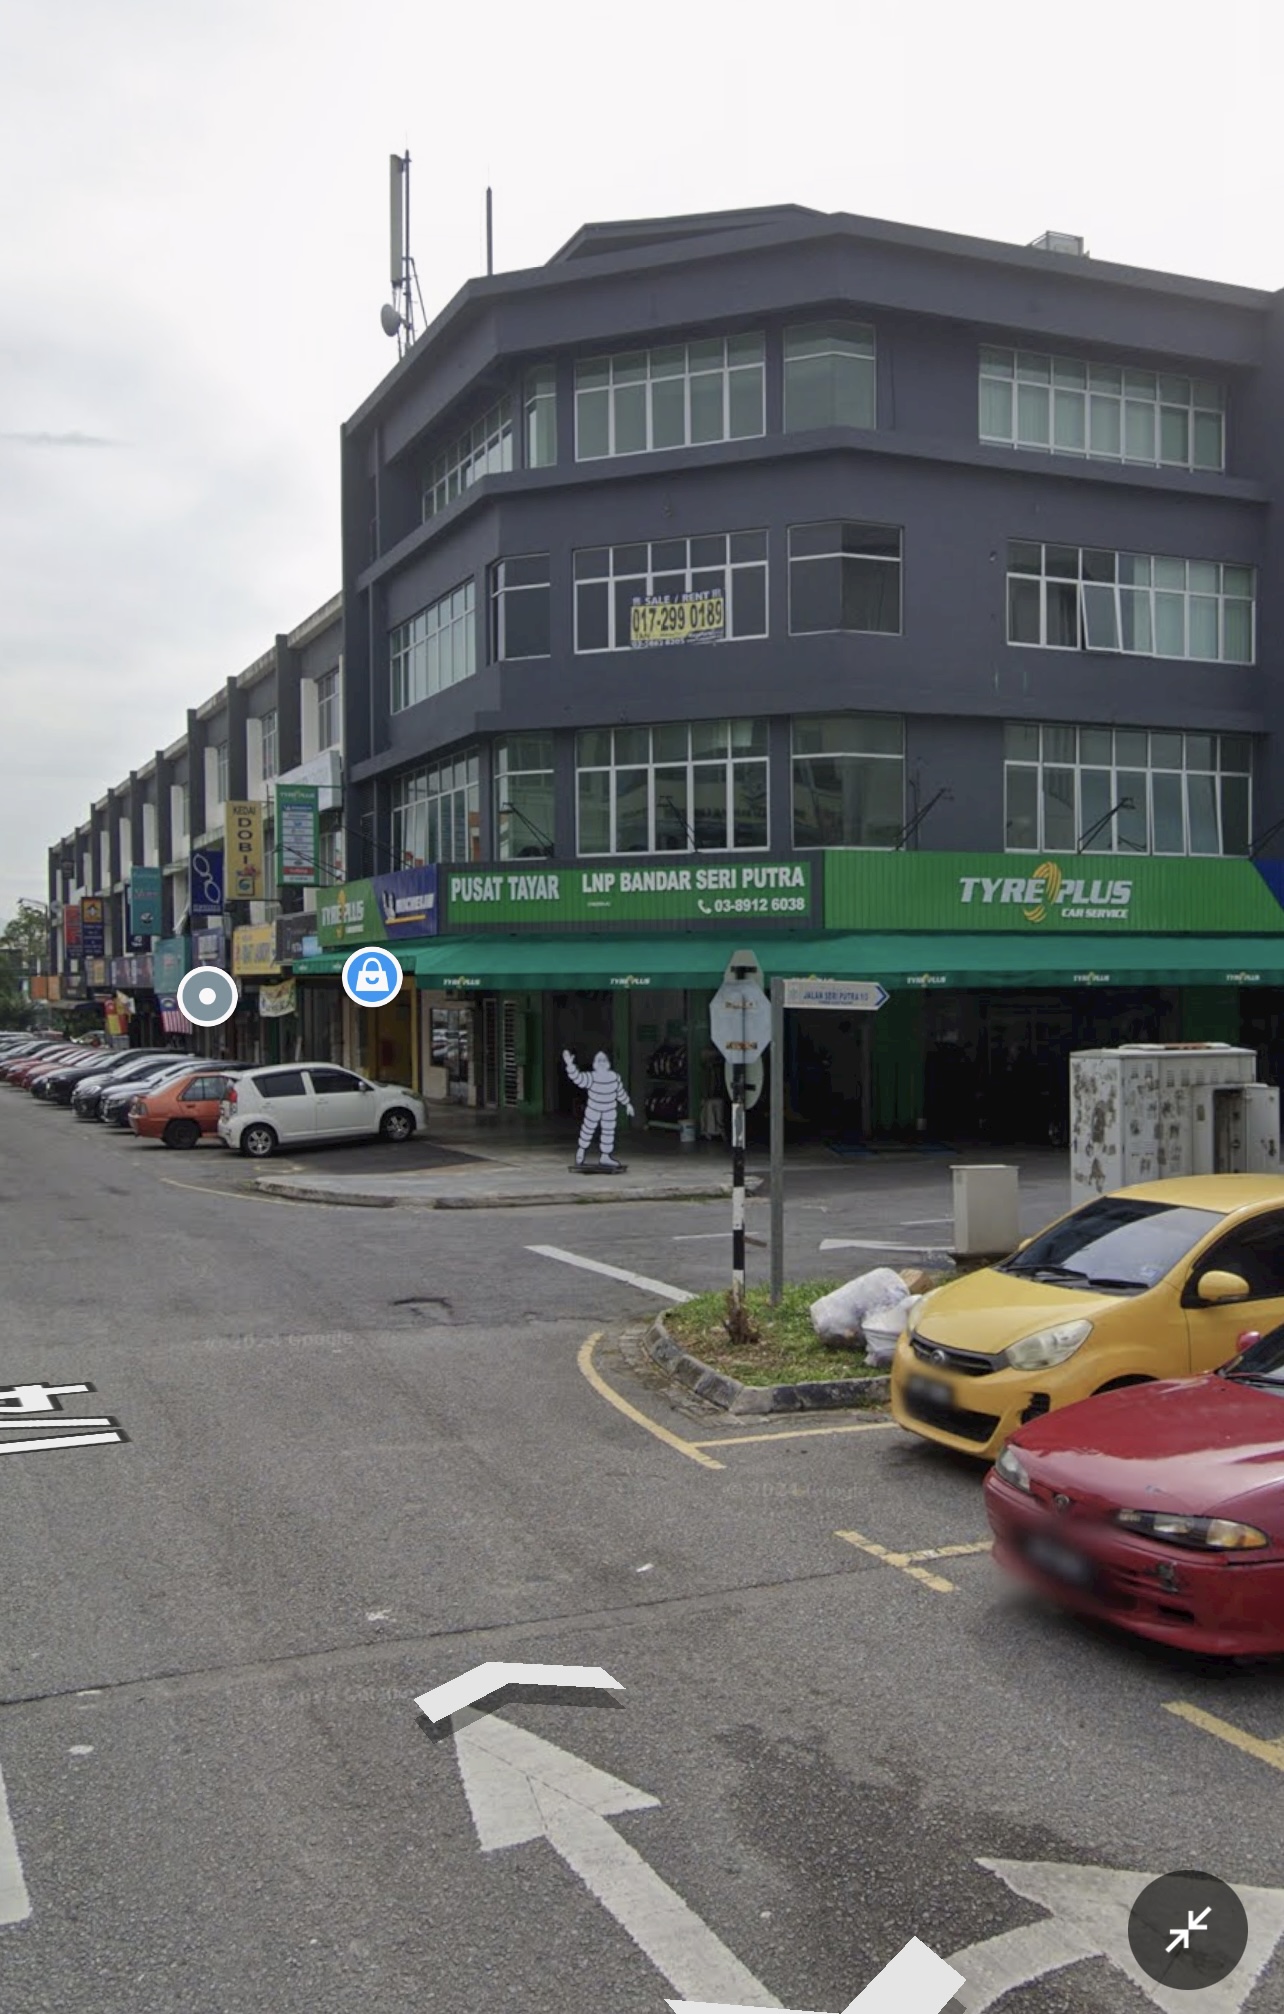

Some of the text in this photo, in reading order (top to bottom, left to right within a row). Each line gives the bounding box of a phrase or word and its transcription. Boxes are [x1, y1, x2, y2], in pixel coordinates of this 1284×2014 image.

[632, 601, 722, 632] 017-299 0189
[233, 806, 256, 815] KEDAI
[450, 866, 805, 902] PUSAT TAYAR LNP BANDAR SERI PUTRA
[714, 897, 805, 912] 03-8912 6038
[1061, 907, 1128, 919] CAR SERVICE
